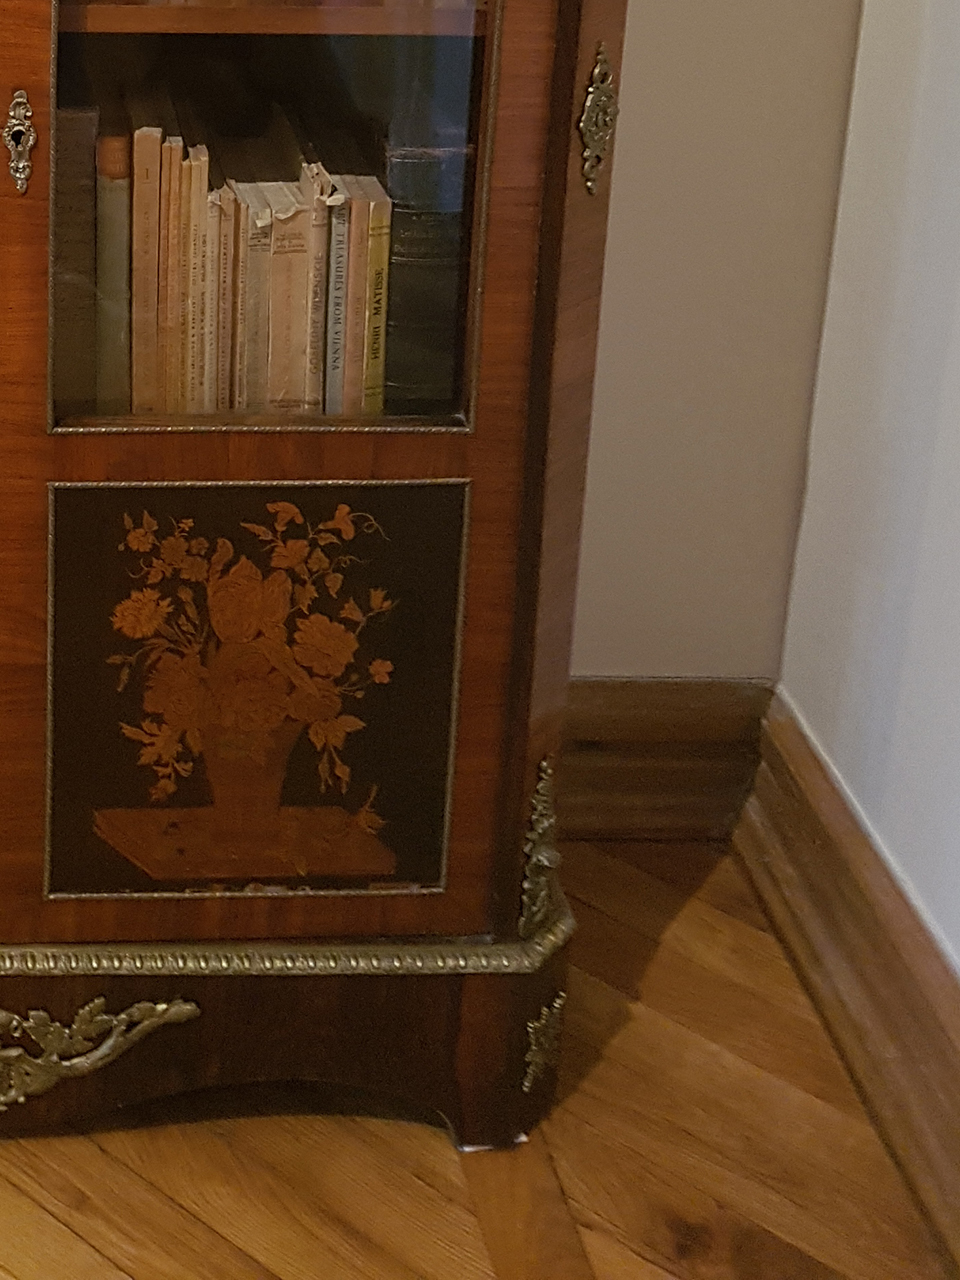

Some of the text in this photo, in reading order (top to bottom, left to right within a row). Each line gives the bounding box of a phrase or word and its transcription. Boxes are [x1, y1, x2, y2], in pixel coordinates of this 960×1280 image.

[334, 232, 345, 291] TREASURES
[333, 295, 343, 325] FROM
[371, 267, 384, 360] HENRI MATISSE
[331, 330, 342, 372] VIENNA
